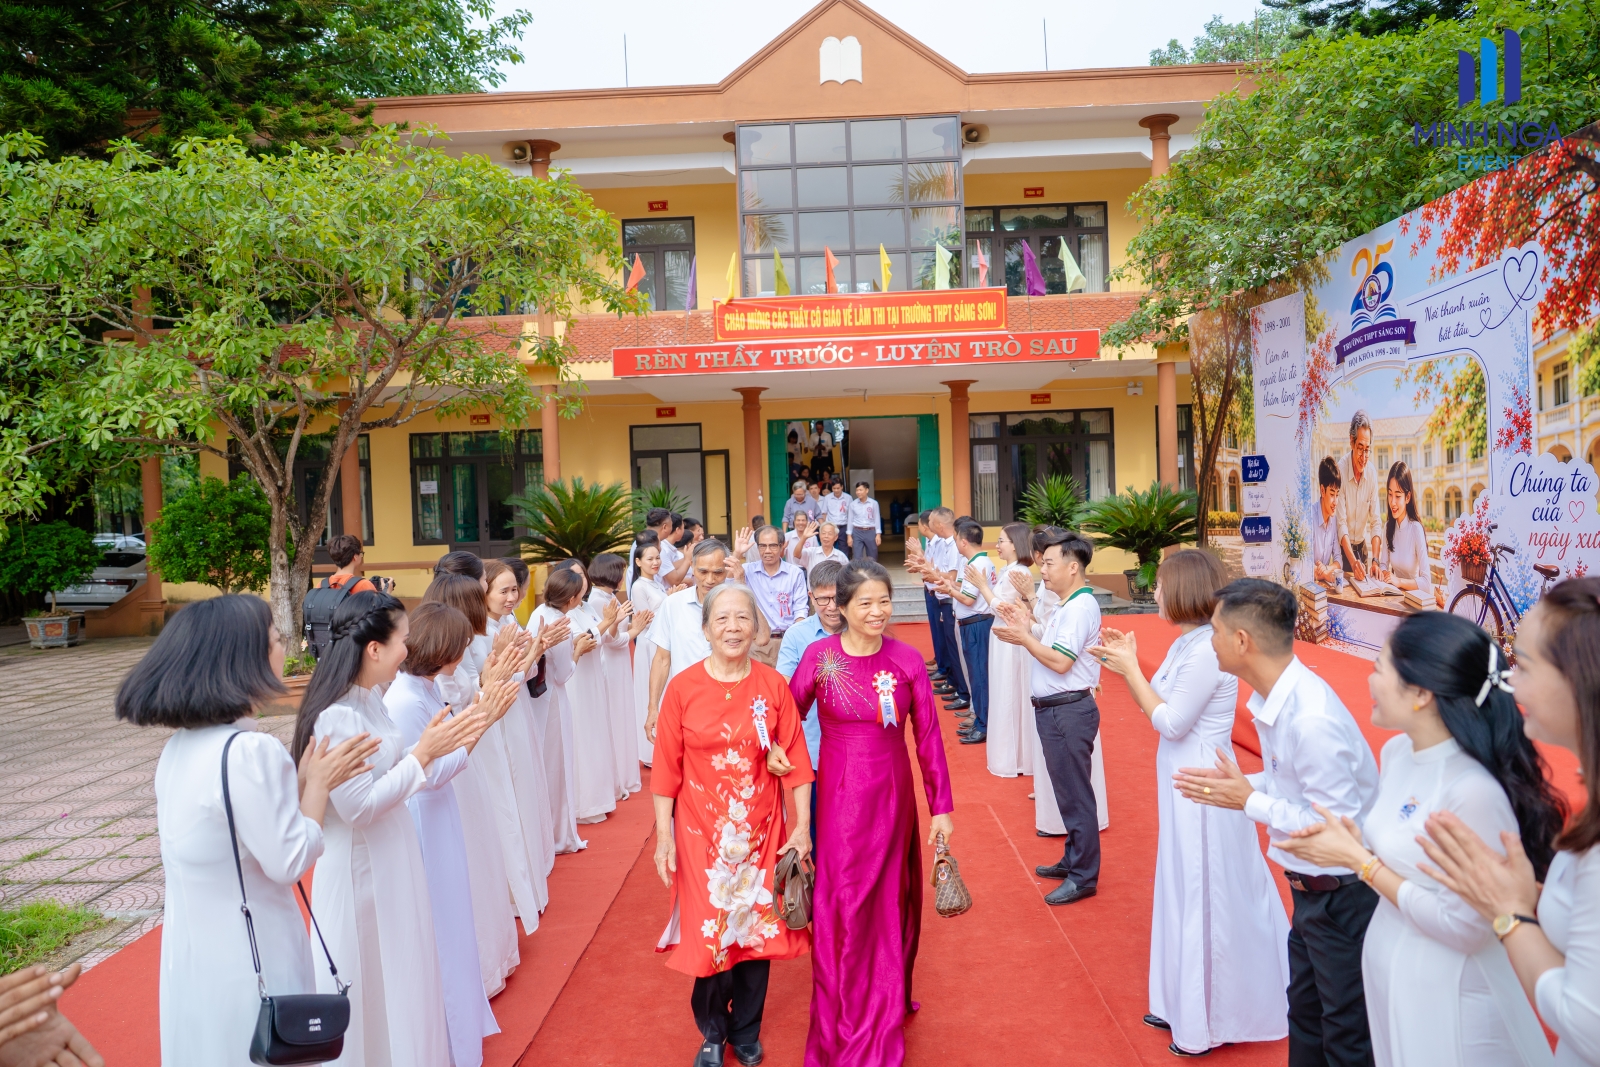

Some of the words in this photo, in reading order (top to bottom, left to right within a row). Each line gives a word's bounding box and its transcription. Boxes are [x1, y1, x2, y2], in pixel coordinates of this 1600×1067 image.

[724, 309, 745, 331] CHÀO
[747, 308, 770, 331] MỪNG
[771, 307, 788, 329] CÁC
[789, 303, 808, 328] THẦY
[810, 306, 821, 328] CÔ
[823, 305, 841, 327] GIÁO
[842, 302, 853, 326] VỀ
[854, 304, 871, 326] LÀM
[873, 306, 885, 325] THI
[887, 306, 899, 329] TẠI
[901, 301, 932, 324] TRƯỜNG
[933, 304, 952, 322] THPT
[954, 299, 976, 322] SÁNG
[977, 301, 997, 321] SƠN!
[1440, 295, 1465, 317] thanh
[1468, 292, 1490, 309] xuân
[1264, 320, 1276, 333] 1998
[1279, 316, 1291, 329] 2001
[1343, 336, 1364, 352] TRƯỜNG
[1364, 329, 1378, 343] THPT
[1378, 328, 1393, 338] SÁNG
[1394, 326, 1406, 335] SƠN
[635, 349, 687, 371] RÈN
[695, 343, 763, 369] THẦY
[771, 342, 854, 366] TRƯỚC
[876, 338, 961, 363] LUYỆN
[970, 334, 1022, 358] TRÒ
[1030, 338, 1078, 357] SAU
[1348, 356, 1357, 369] HỘI
[1375, 347, 1386, 357] 1998
[1389, 346, 1401, 356] 2001
[1510, 461, 1567, 505] Chúng
[1570, 467, 1592, 493] ta
[1532, 498, 1564, 522] của
[1528, 525, 1573, 561] ngày
[1575, 531, 1600, 549] xư
